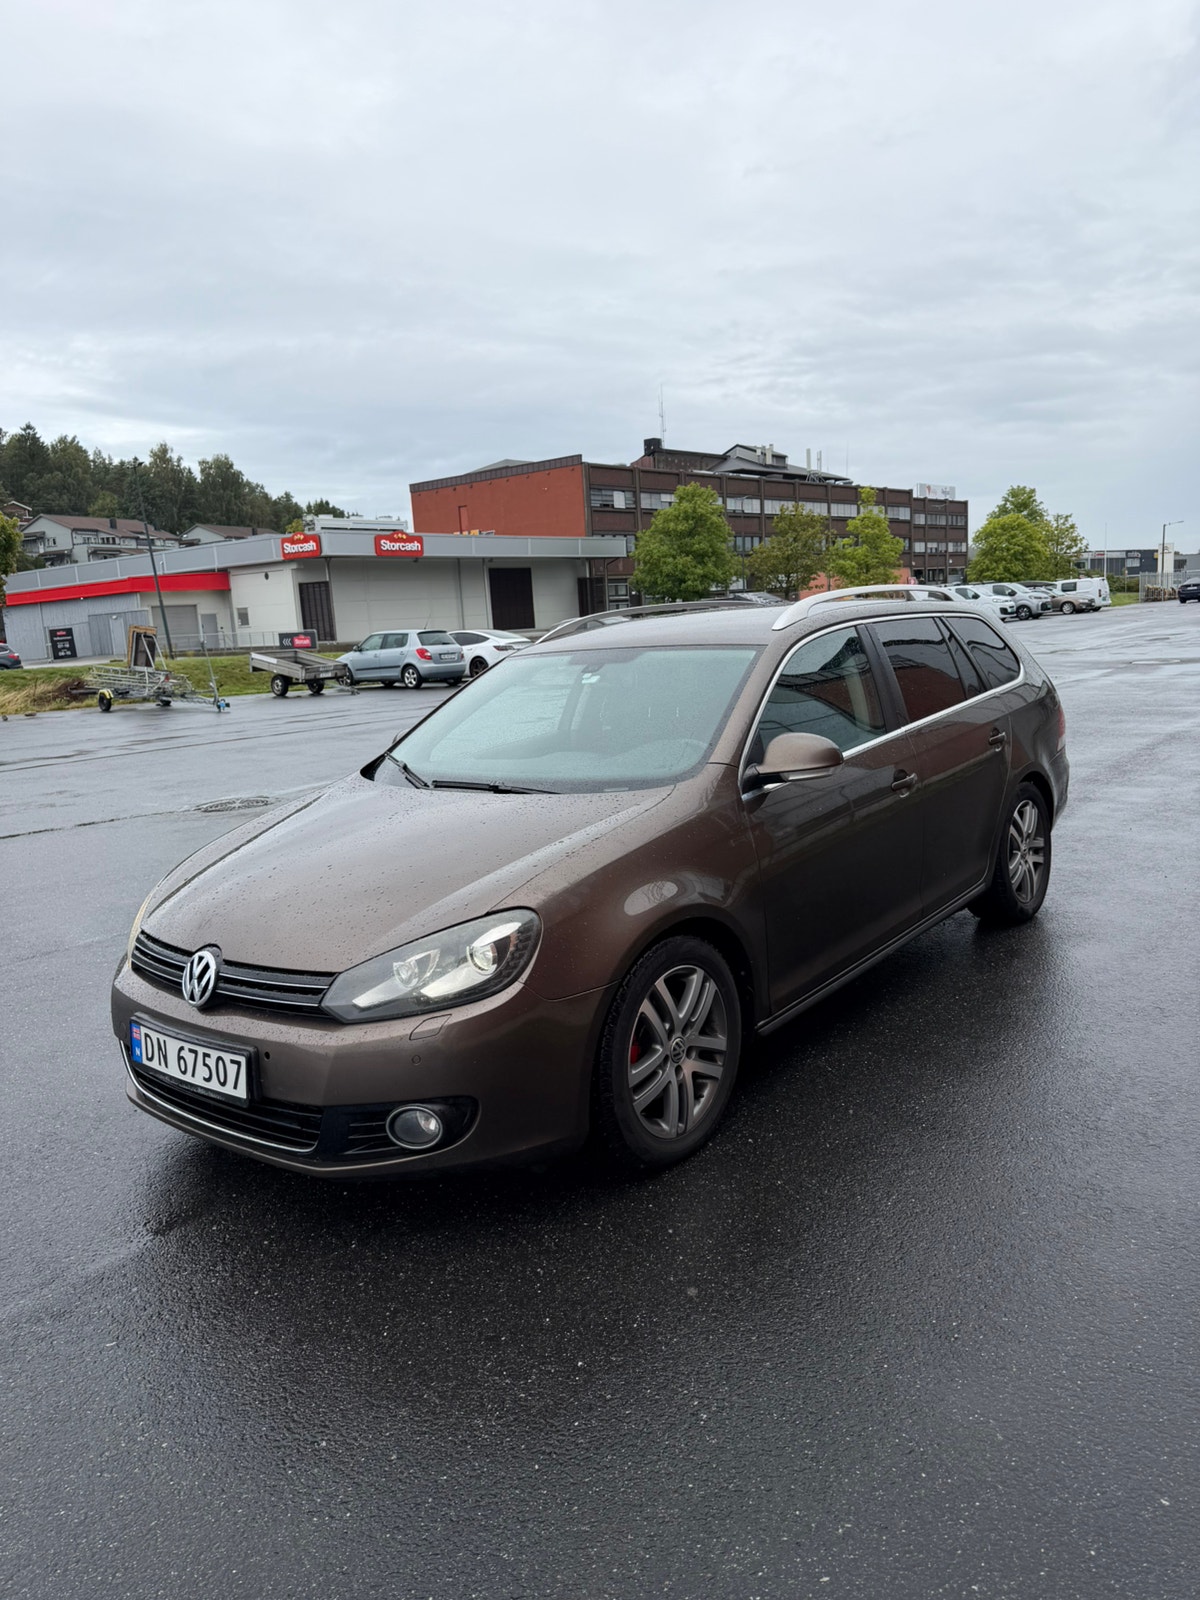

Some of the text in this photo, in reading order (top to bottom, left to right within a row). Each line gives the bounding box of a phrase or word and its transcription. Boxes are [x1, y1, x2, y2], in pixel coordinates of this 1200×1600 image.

[284, 541, 317, 553] Storcash
[380, 540, 421, 551] Storcash
[135, 1047, 141, 1056] N
[144, 1032, 168, 1069] DN
[177, 1046, 242, 1090] 67507
